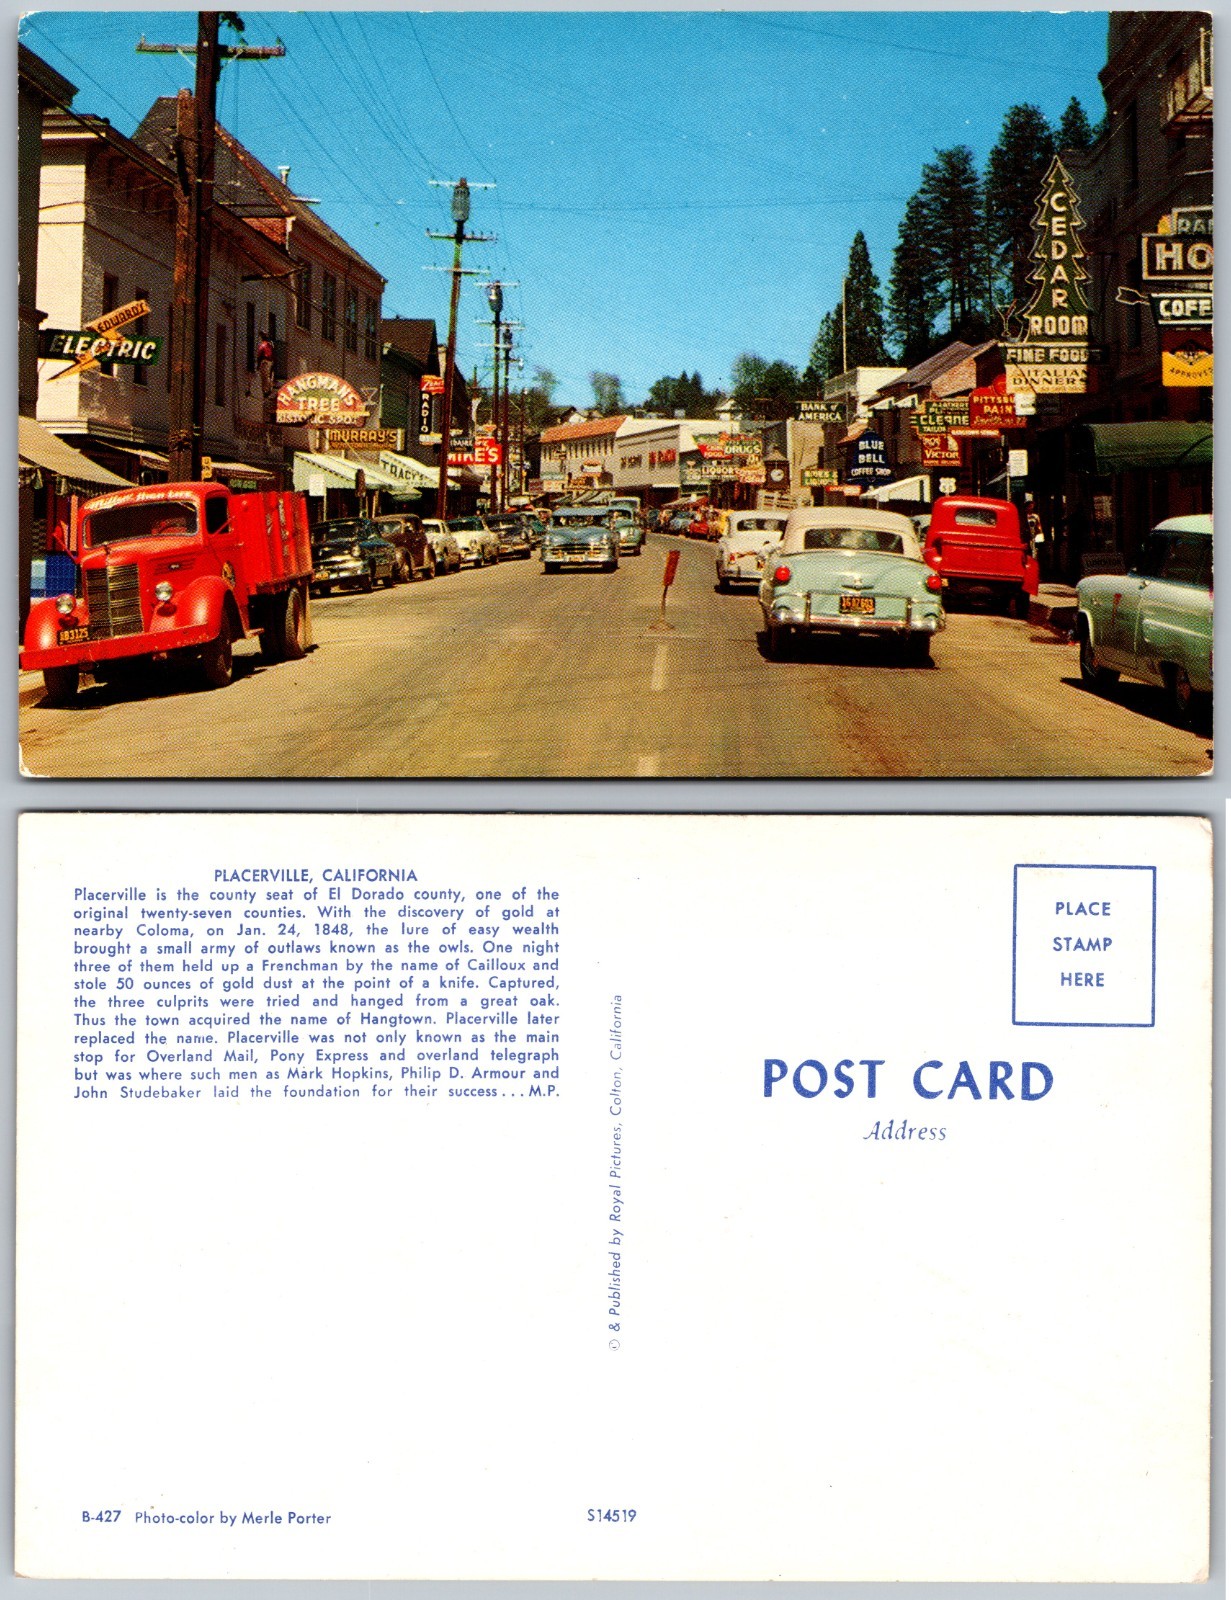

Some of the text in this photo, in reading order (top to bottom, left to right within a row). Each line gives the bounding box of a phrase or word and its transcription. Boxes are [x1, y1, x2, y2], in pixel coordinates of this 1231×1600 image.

[1050, 192, 1070, 308] CEDAR
[1155, 243, 1213, 271] HO
[97, 302, 146, 333] EDWARD'S
[1030, 315, 1088, 336] ROOM
[49, 335, 156, 360] ELECTRIC
[1007, 349, 1045, 362] FINE
[278, 376, 357, 407] HANGMANS
[974, 396, 1014, 404] PITTSBU
[298, 397, 340, 412] TREE
[421, 393, 430, 433] RADIO
[801, 402, 828, 411] BANK
[984, 405, 1013, 414] PAIN
[277, 414, 357, 424] HISTOIC SPOT
[798, 412, 842, 421] AMERICA
[920, 415, 969, 425] CLEANE
[330, 430, 398, 443] MURRAY'S
[725, 445, 761, 455] DRUGS
[858, 441, 885, 451] BLUE
[858, 453, 886, 464] BELL
[381, 459, 425, 481] TRACY'S
[851, 468, 892, 476] COFFEE SHOP
[214, 868, 417, 883] PLACERVILLE, CALIFORNIA
[74, 886, 560, 904] Placerville is the county seat of El Dorado county, one of the
[73, 904, 560, 922] original twenty-seven counties. With the discovery of gold at
[1055, 901, 1111, 917] PLACE
[74, 921, 559, 940] nearby Coloma, on Jan. 24, 1848, the lure of easy wealth
[1052, 936, 1113, 952] STAMP
[73, 957, 559, 975] three of them held up a Frenchman by the name of Cailloux and
[1060, 972, 1105, 988] HERE
[73, 993, 560, 1011] the three culprits were tried and hanged from a great oak.
[73, 1011, 560, 1028] Thus the town acquired the name of Hangtown. Placerville later
[609, 994, 622, 1061] California
[74, 1065, 559, 1083] but was where such men as Mark Hopkins, Philip D. Armour and
[763, 1058, 1054, 1102] POST CARD
[75, 1085, 108, 1099] John
[120, 1085, 200, 1099] Studebaker
[213, 1085, 239, 1098] laid
[250, 1085, 272, 1098] the
[283, 1084, 360, 1098] foundation
[372, 1084, 391, 1097] for
[404, 1084, 437, 1097] their
[528, 1084, 560, 1097] M.P.
[609, 1067, 623, 1117] Colton,
[864, 1119, 946, 1141] Address
[609, 1120, 623, 1180] Pictures,
[608, 1184, 624, 1222] Royal
[608, 1228, 623, 1246] by
[607, 1251, 620, 1316] Published
[608, 1322, 620, 1332] &
[82, 1509, 331, 1527] B-427 Photo-color by Merle Porter
[587, 1508, 637, 1523] S14519
